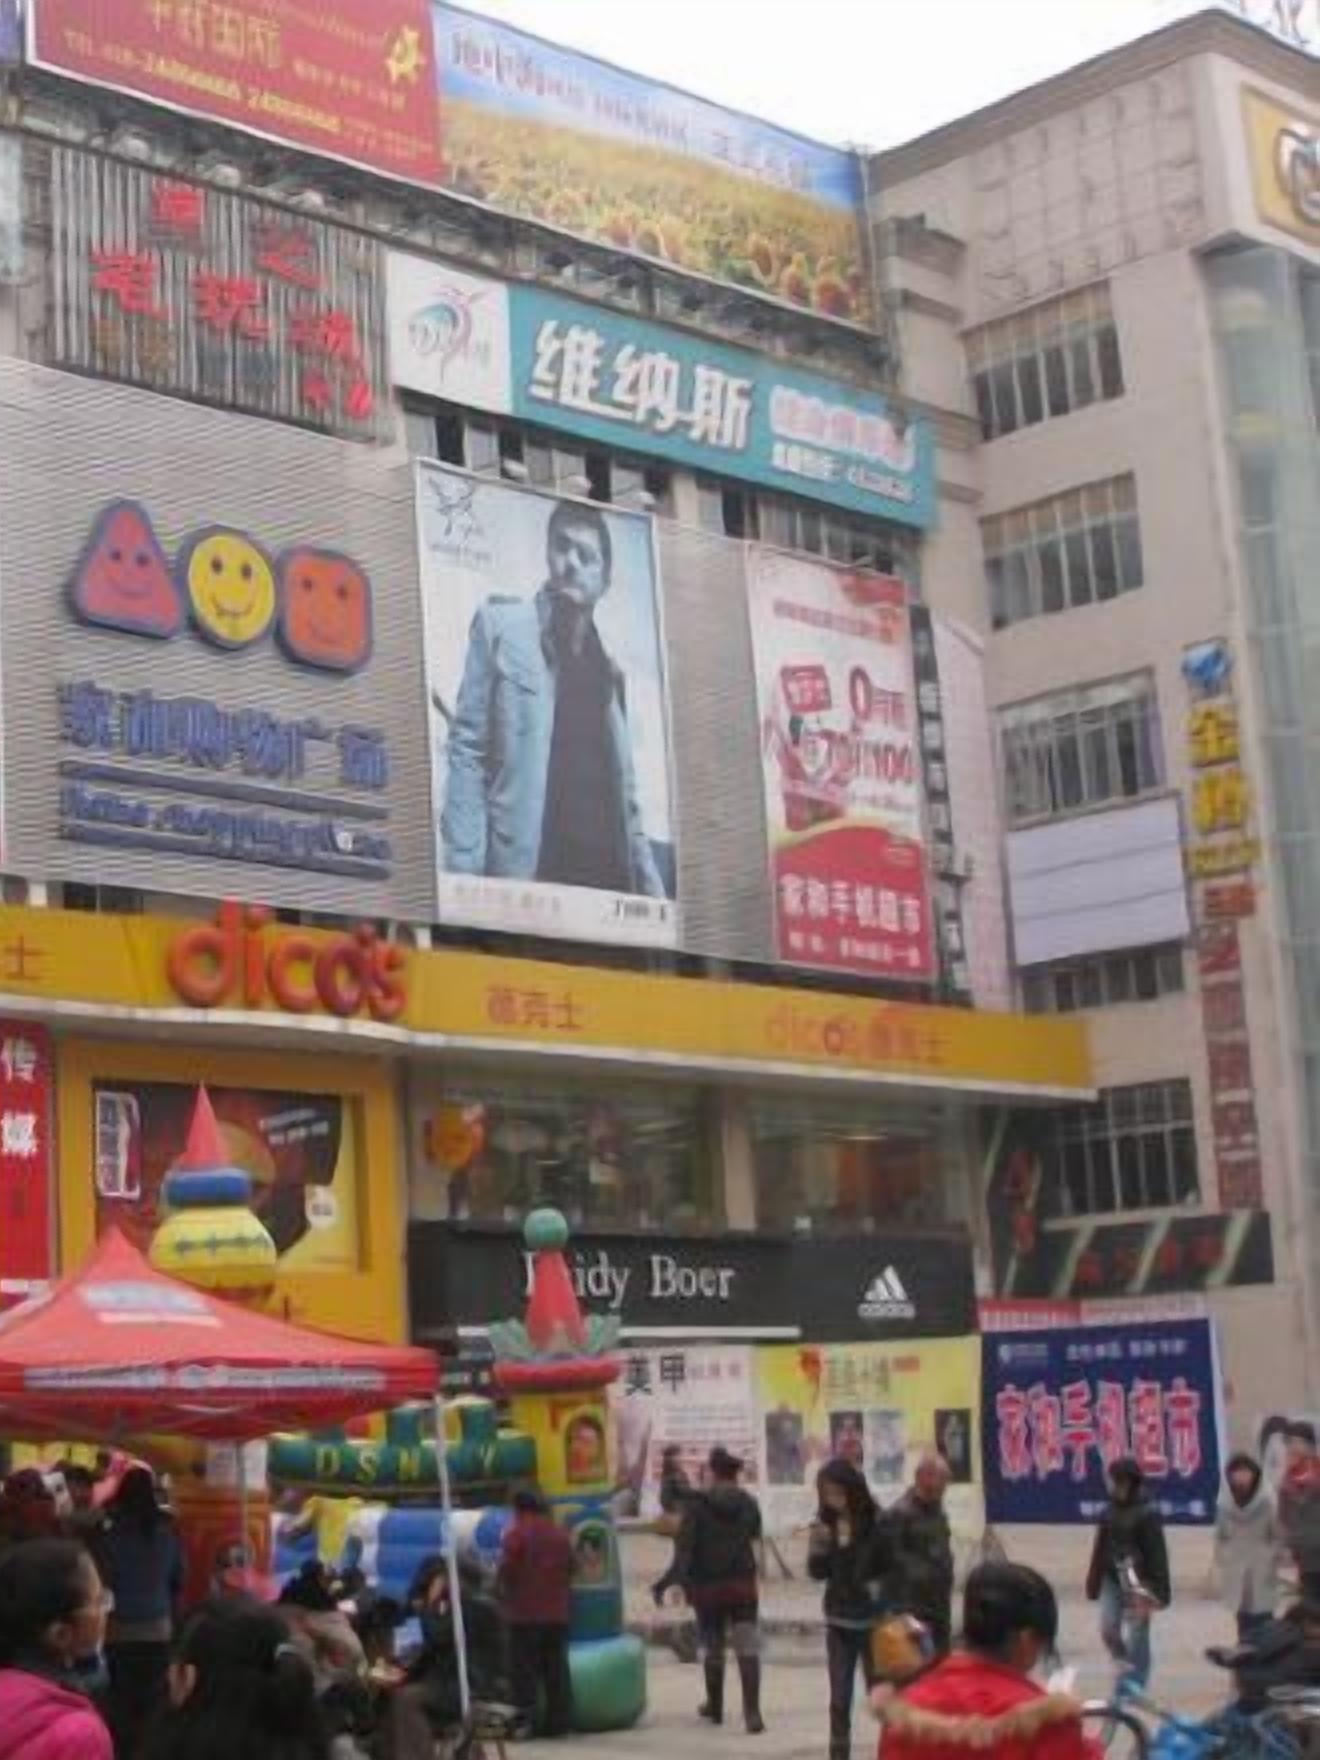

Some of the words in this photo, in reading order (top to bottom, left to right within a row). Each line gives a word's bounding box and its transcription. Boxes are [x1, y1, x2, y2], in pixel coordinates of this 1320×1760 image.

[528, 319, 755, 451] 维纳斯
[650, 1254, 735, 1298] Boer
[624, 1353, 685, 1396] 美甲
